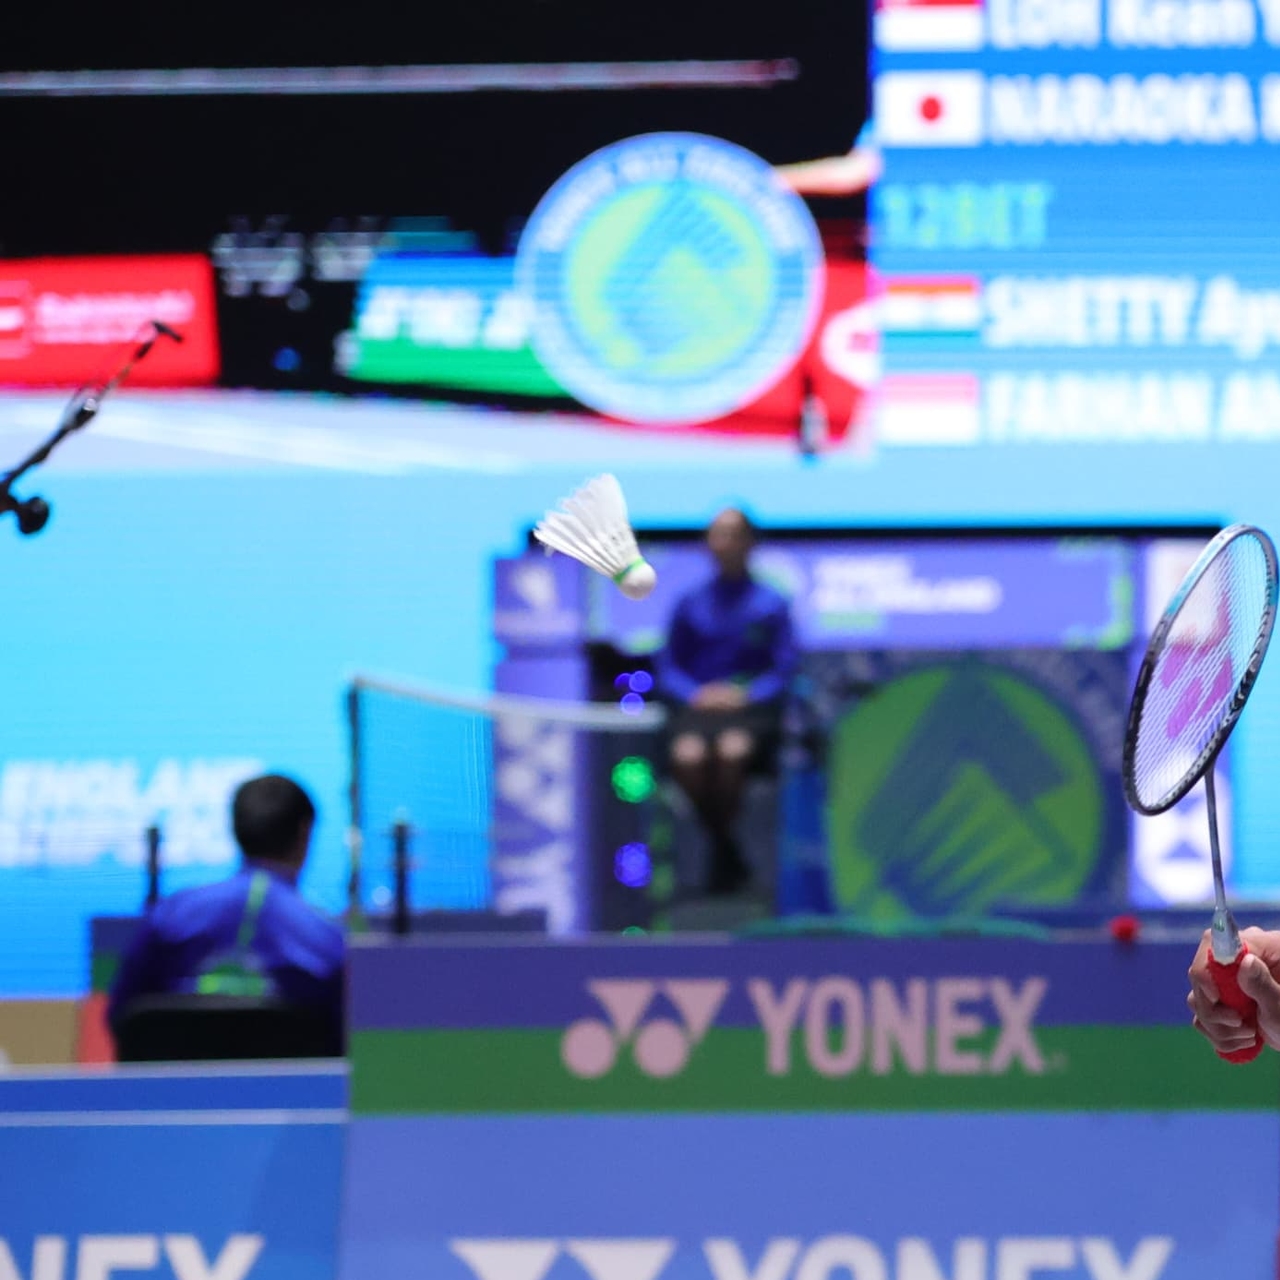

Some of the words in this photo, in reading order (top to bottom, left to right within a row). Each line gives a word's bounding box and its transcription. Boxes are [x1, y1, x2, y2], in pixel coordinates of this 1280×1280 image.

[986, 73, 1256, 144] NARAOKA
[983, 274, 1198, 347] SHETTY
[749, 978, 1048, 1076] YONEX
